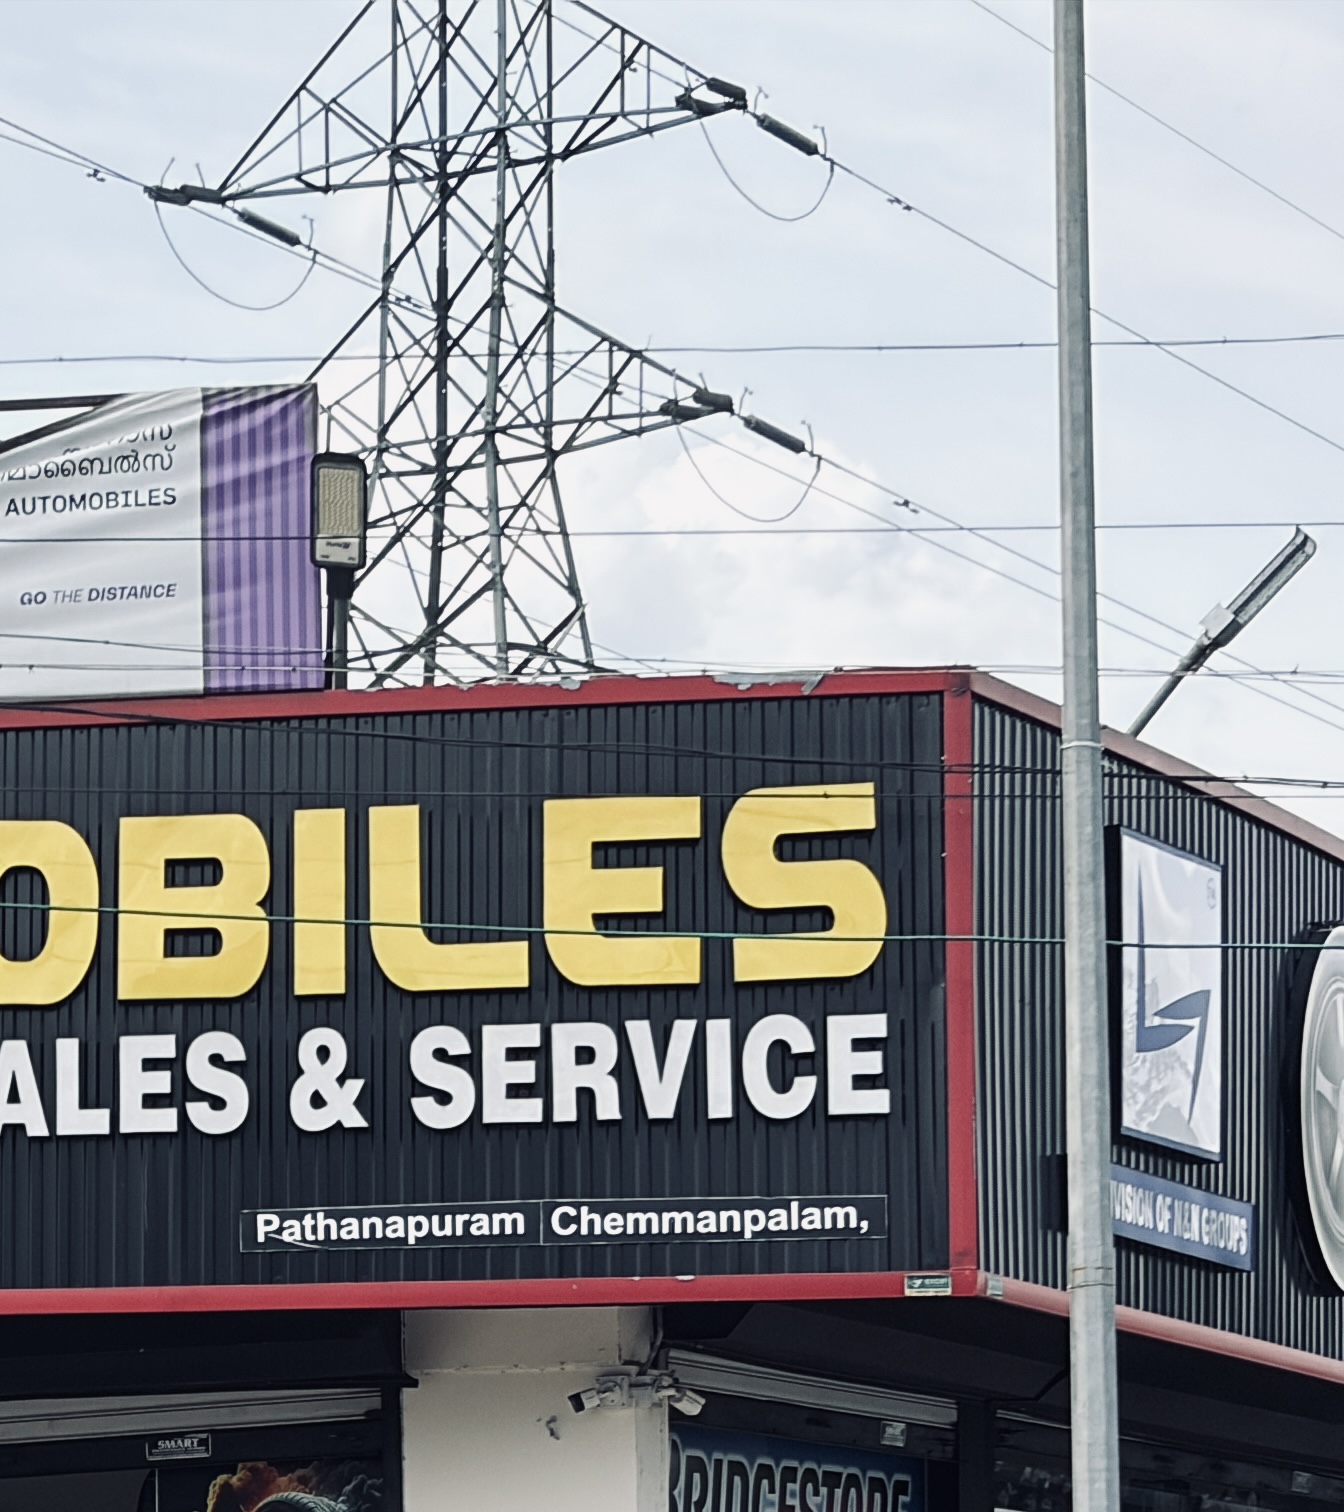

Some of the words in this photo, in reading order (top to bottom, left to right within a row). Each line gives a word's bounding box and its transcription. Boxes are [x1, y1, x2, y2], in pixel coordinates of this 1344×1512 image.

[5, 488, 177, 517] AUTOMOBILES
[20, 592, 47, 605] GO
[53, 588, 84, 604] THE
[87, 583, 177, 602] DISTANCE
[288, 1026, 369, 1132] &
[409, 1012, 891, 1130] SERVICE
[256, 1208, 525, 1244] Pathanapuram
[550, 1202, 870, 1240] Chemmanpalam,
[1156, 1193, 1172, 1234] OF
[1201, 1207, 1248, 1257] GROUPS
[157, 1438, 199, 1449] SMART
